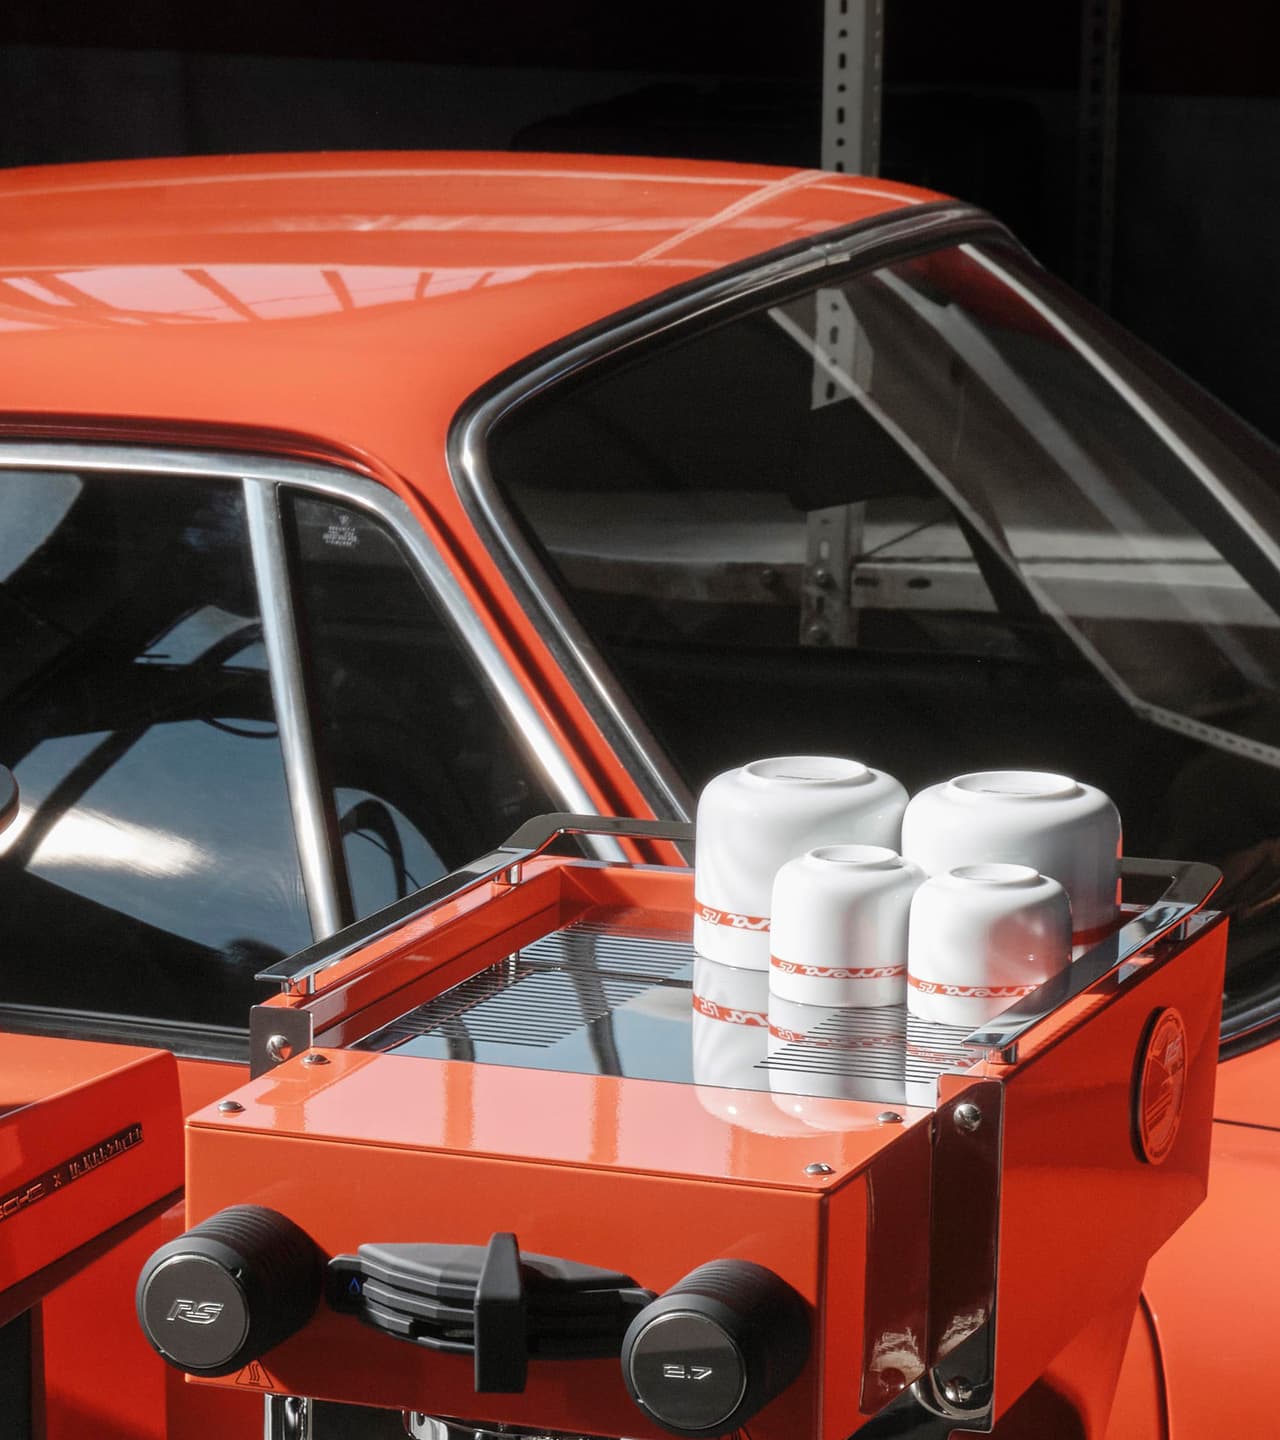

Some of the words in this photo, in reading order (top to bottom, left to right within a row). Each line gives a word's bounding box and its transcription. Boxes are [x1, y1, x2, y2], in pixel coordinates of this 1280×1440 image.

[801, 965, 904, 979] arrera
[166, 1299, 224, 1325] RS
[663, 1363, 713, 1380] 2.7
